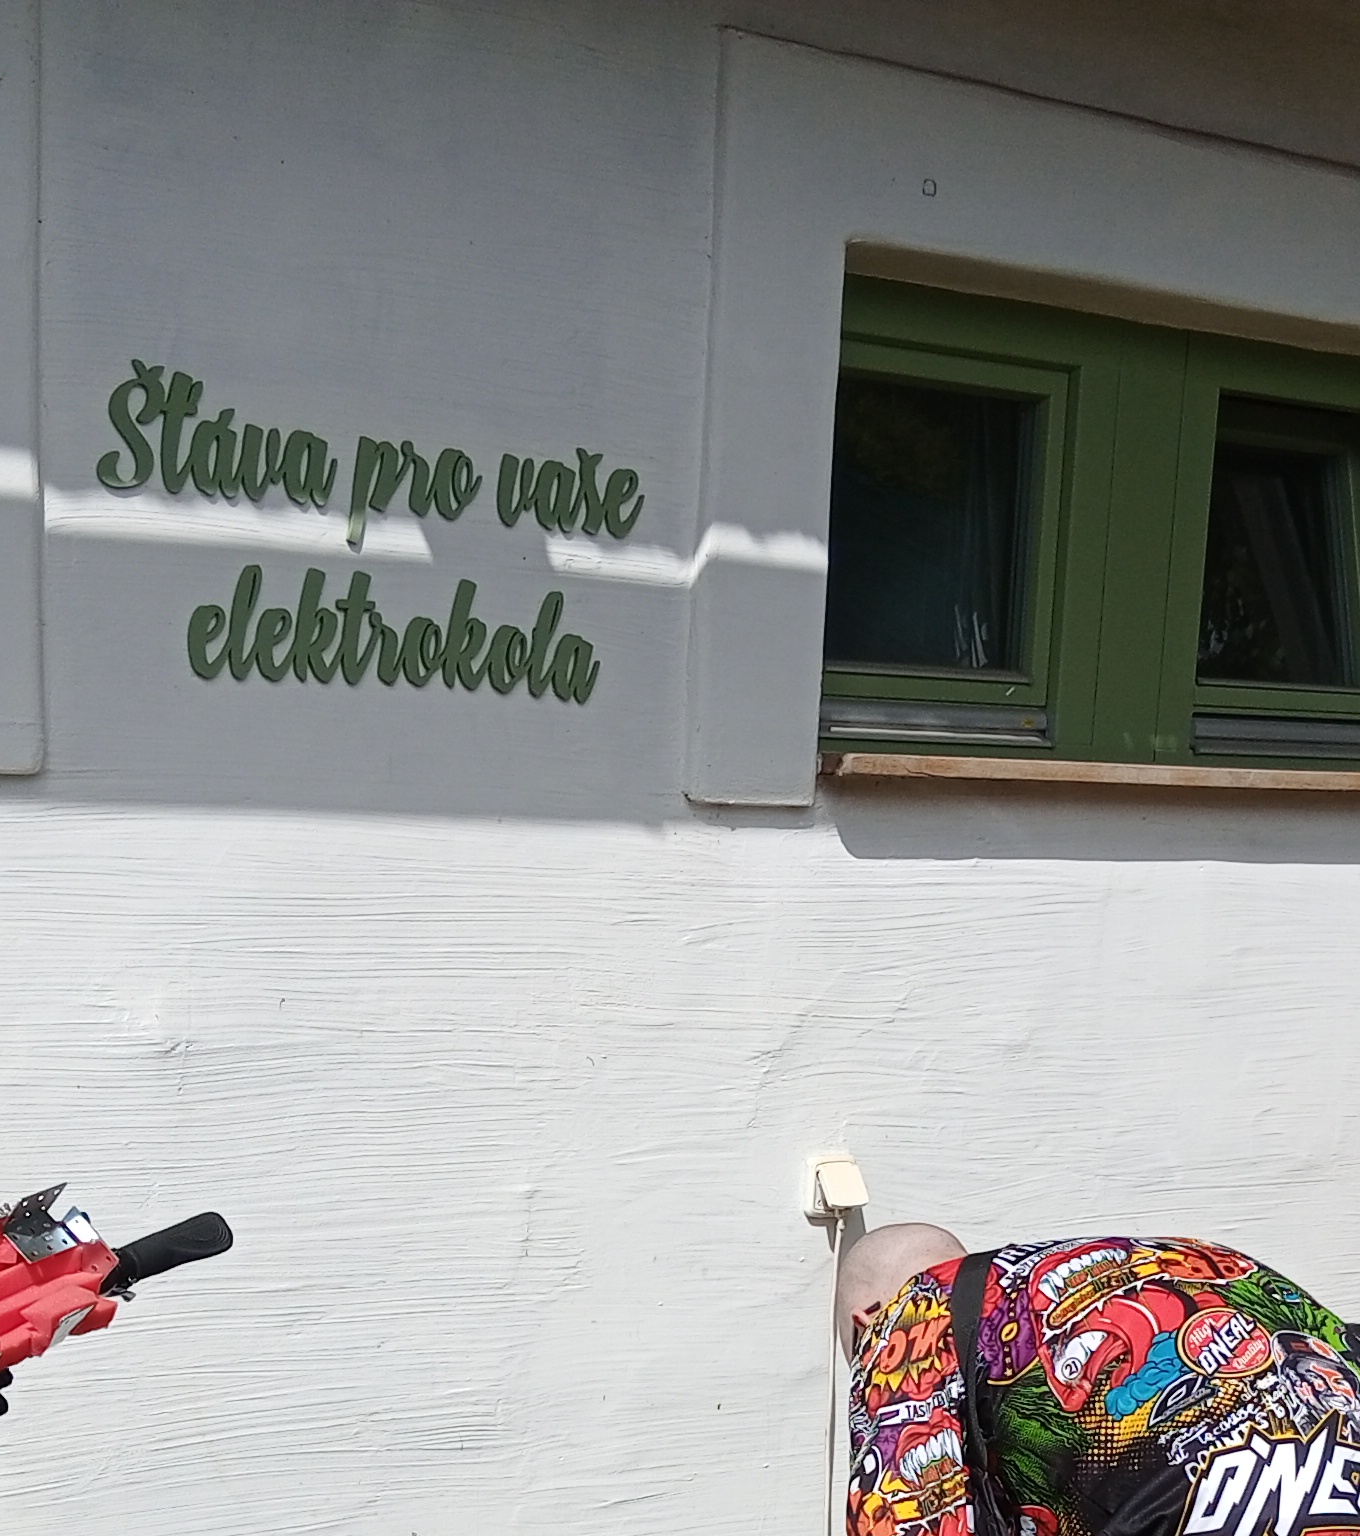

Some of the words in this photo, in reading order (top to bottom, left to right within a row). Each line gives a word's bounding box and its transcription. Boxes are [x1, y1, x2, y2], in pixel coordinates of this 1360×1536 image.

[344, 435, 482, 546] pro
[496, 447, 645, 540] vaše
[187, 564, 601, 705] elektrokola
[1064, 1361, 1080, 1377] 21
